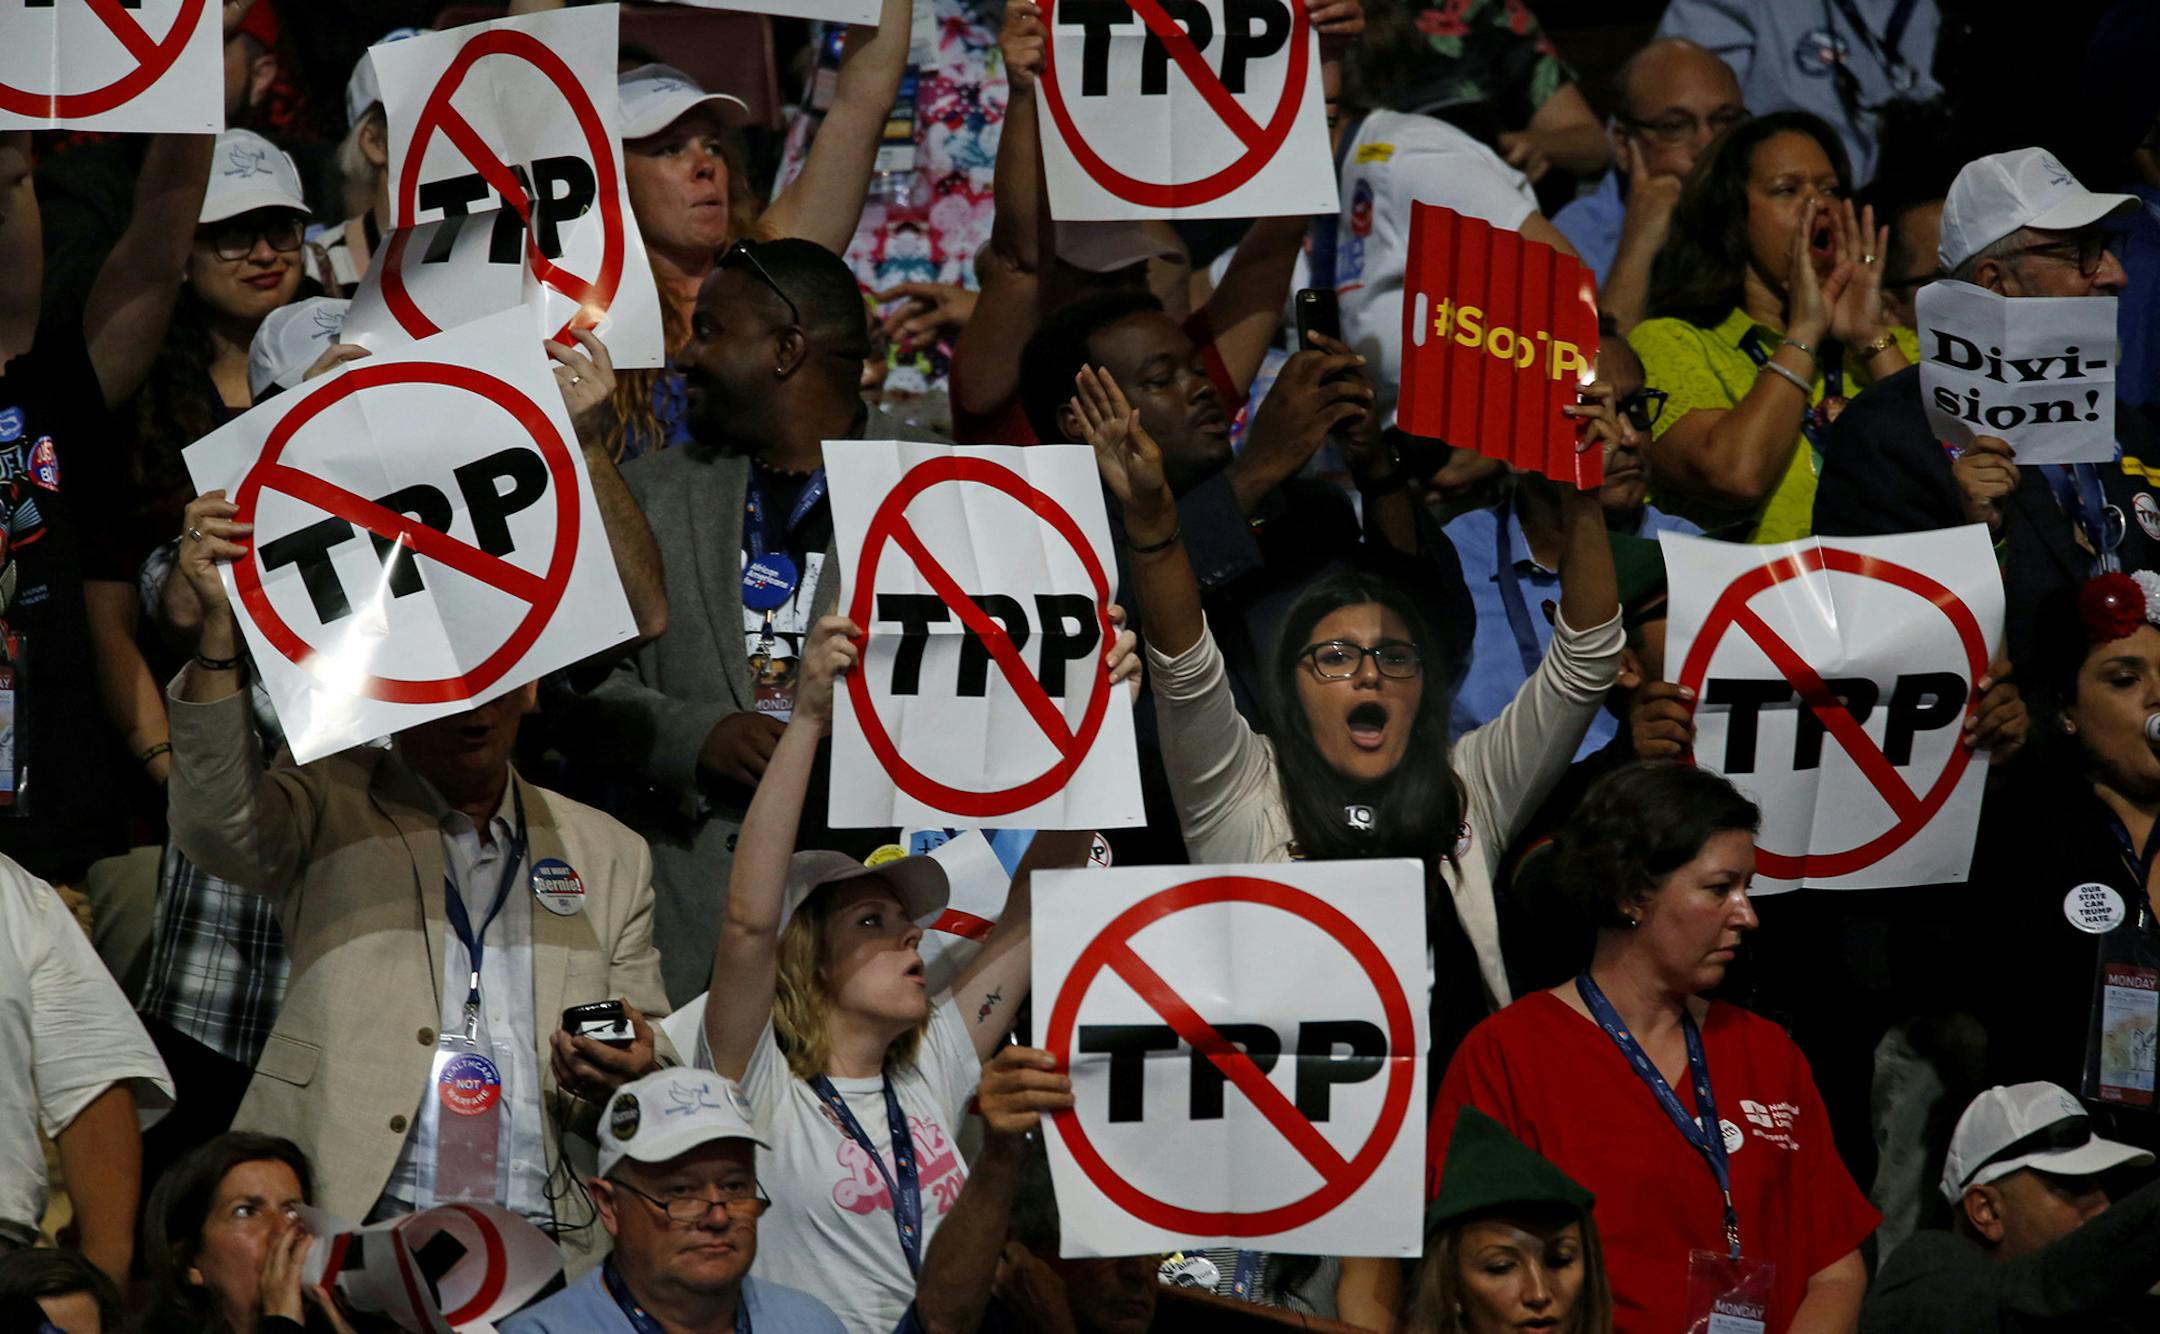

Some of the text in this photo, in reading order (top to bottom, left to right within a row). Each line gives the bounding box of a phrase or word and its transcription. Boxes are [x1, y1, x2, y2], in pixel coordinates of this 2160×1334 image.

[1058, 0, 1291, 96] TPP
[419, 155, 596, 264] TPP
[1929, 328, 2107, 384] Divi-
[1933, 386, 2100, 430] sion!
[258, 447, 549, 625] TPP
[876, 593, 1101, 698] TPP
[1704, 672, 1968, 774] TPP
[2079, 907, 2112, 915] TRUMP
[2085, 915, 2110, 923] HATE
[2108, 974, 2156, 990] MONDAY
[456, 1079, 481, 1090] NOT
[1078, 1020, 1388, 1123] TPP
[1714, 1299, 1765, 1320] MONDAY
